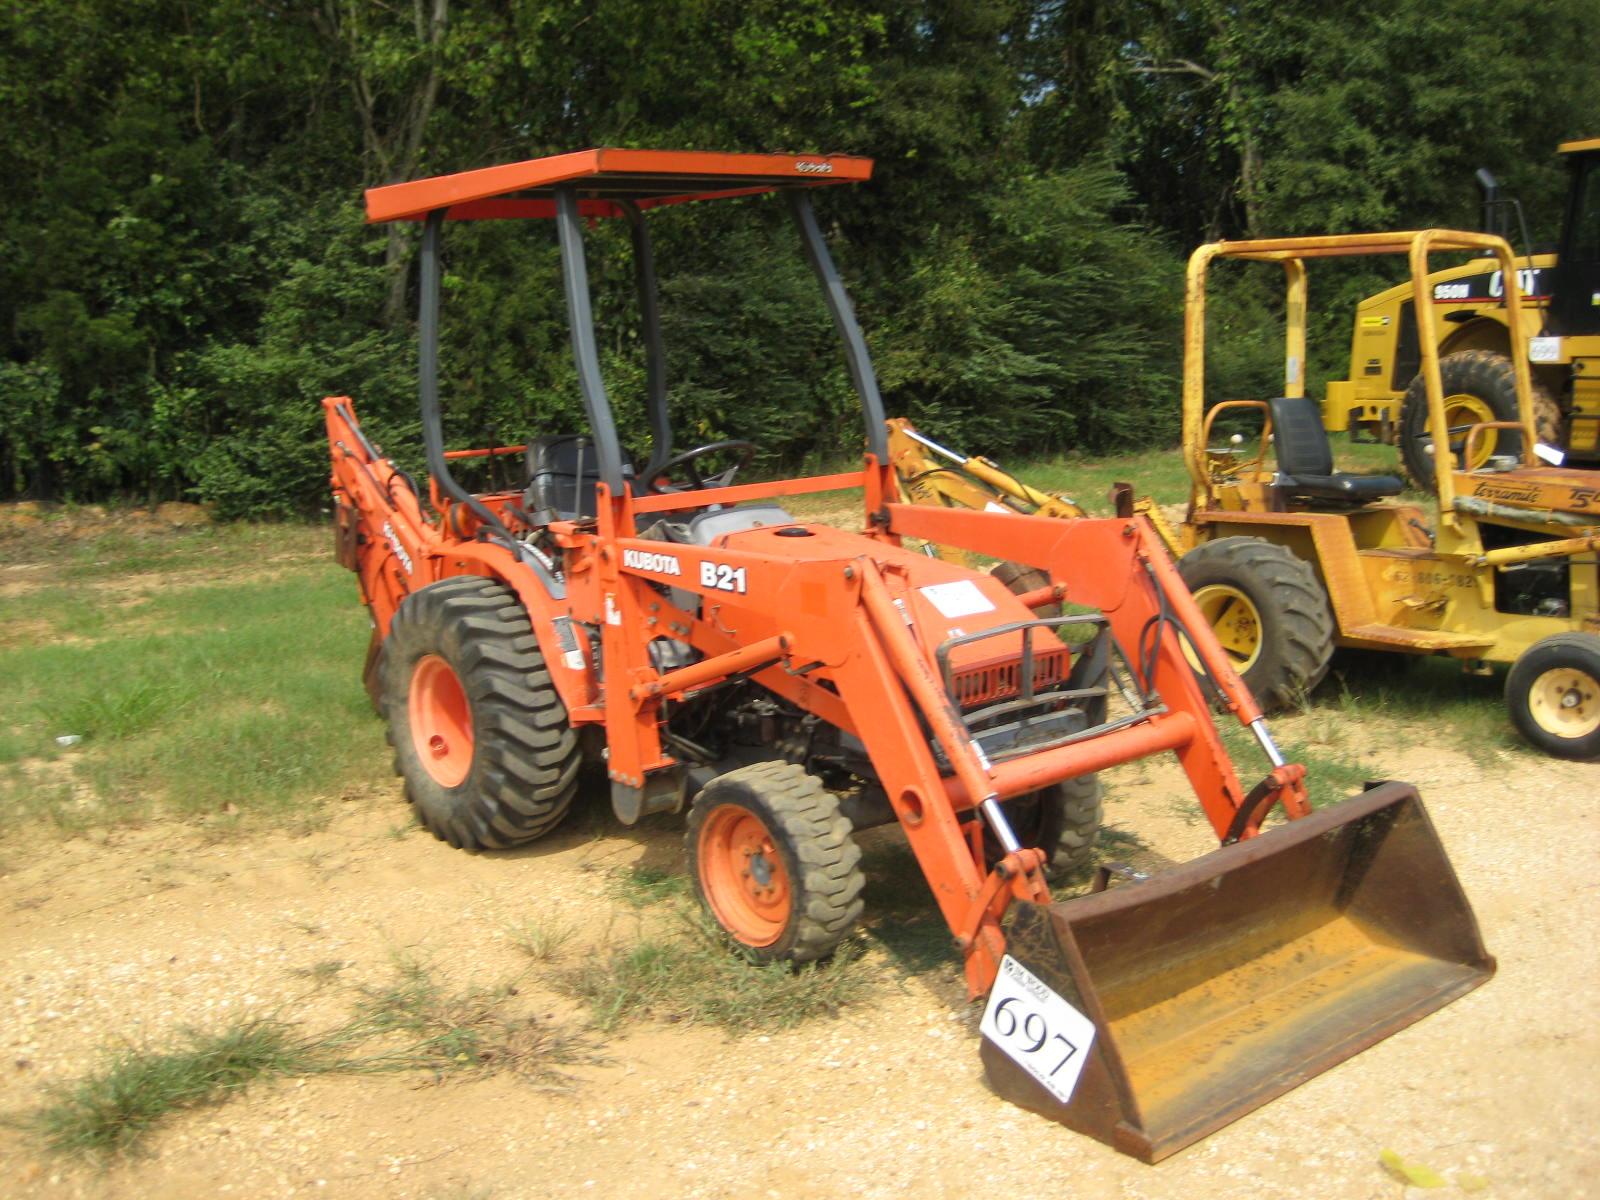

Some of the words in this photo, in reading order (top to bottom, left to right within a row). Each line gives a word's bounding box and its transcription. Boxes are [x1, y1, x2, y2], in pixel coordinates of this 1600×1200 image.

[623, 549, 681, 576] KUBOTA
[700, 561, 747, 594] B21
[994, 996, 1078, 1077] 697
